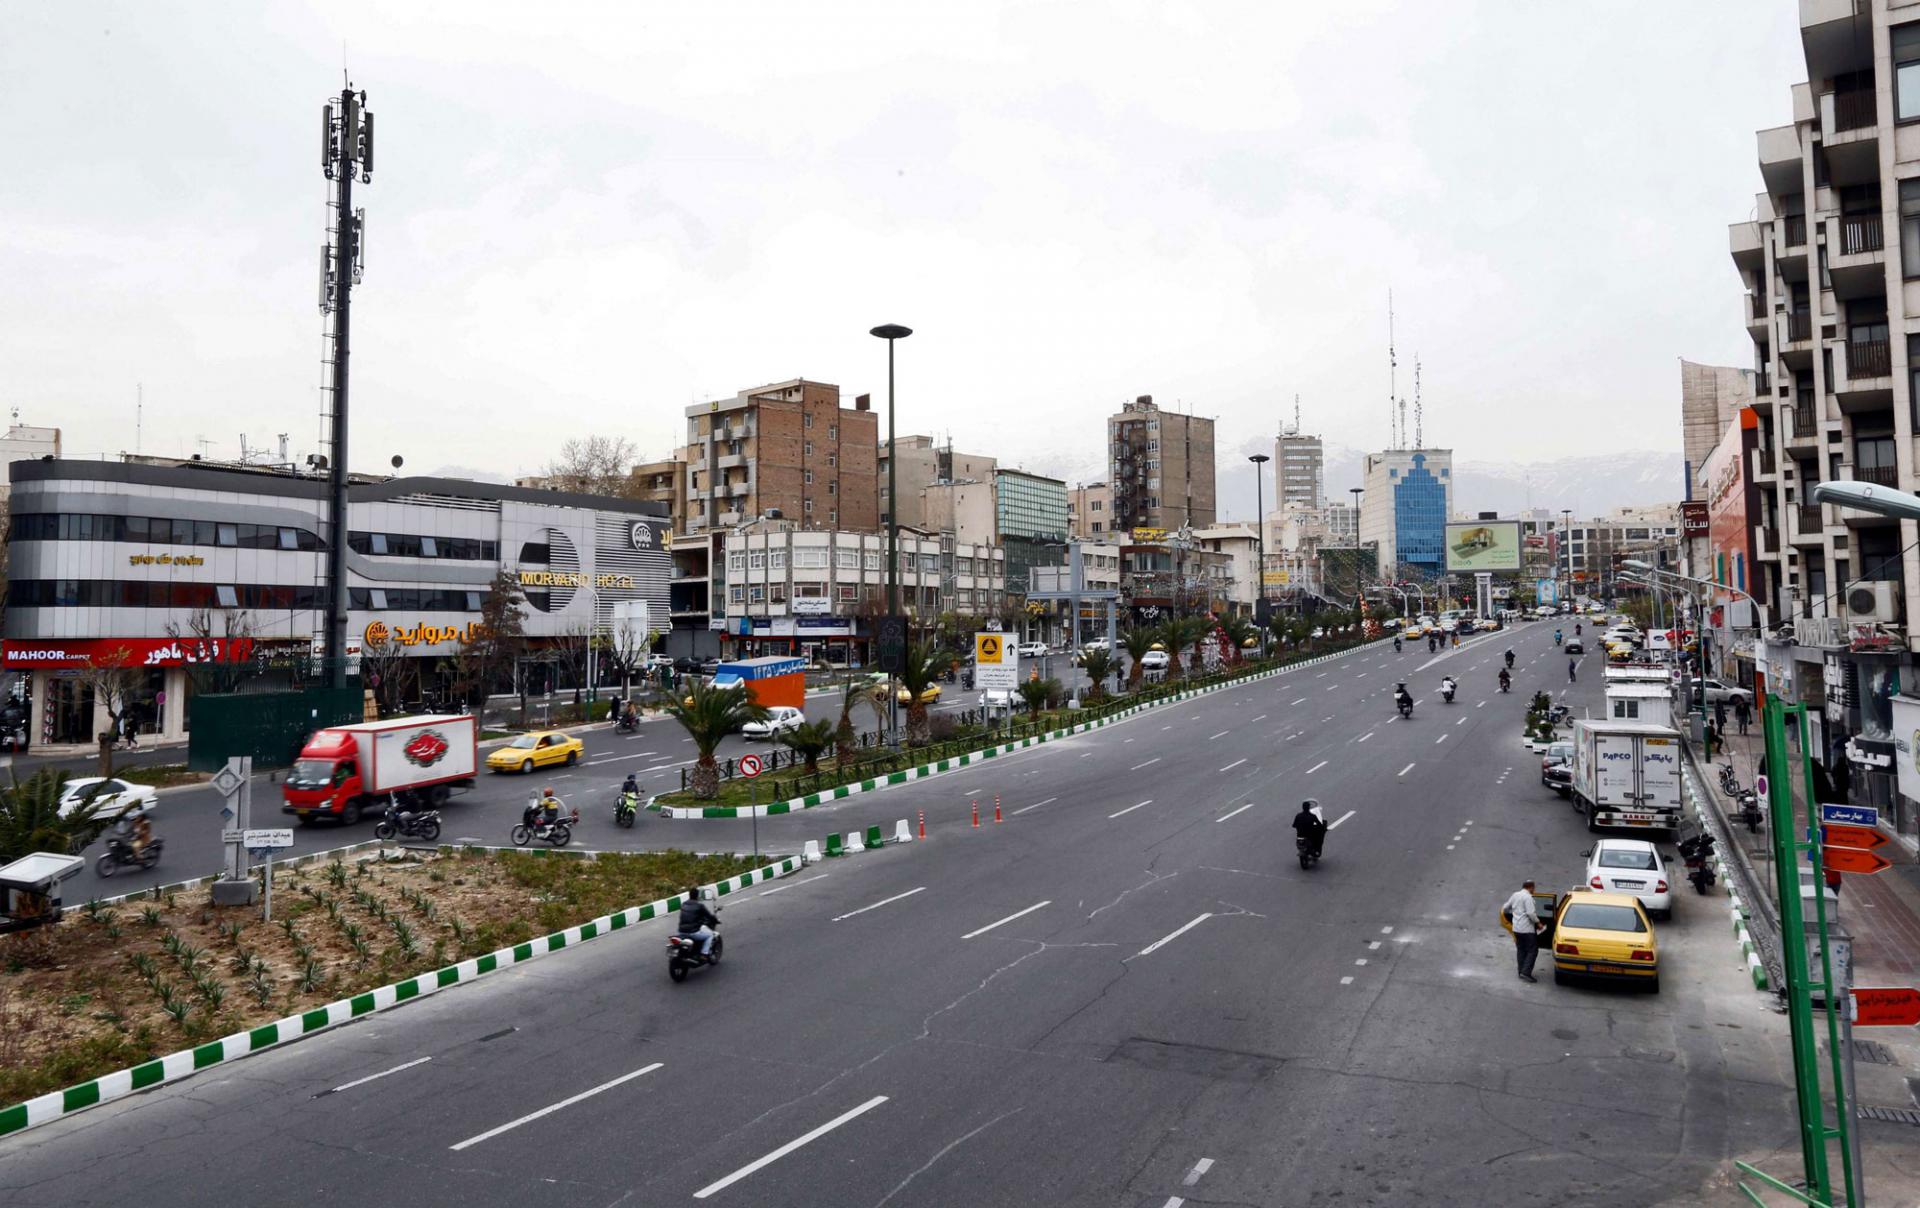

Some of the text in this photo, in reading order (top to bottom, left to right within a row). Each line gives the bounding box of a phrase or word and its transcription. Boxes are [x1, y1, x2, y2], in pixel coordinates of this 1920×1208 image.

[520, 571, 635, 589] MORVARID HOTEL
[394, 622, 457, 645] مروارید
[7, 650, 65, 660] MAHOOR
[143, 641, 182, 664] ماهور
[272, 831, 291, 839] میدان
